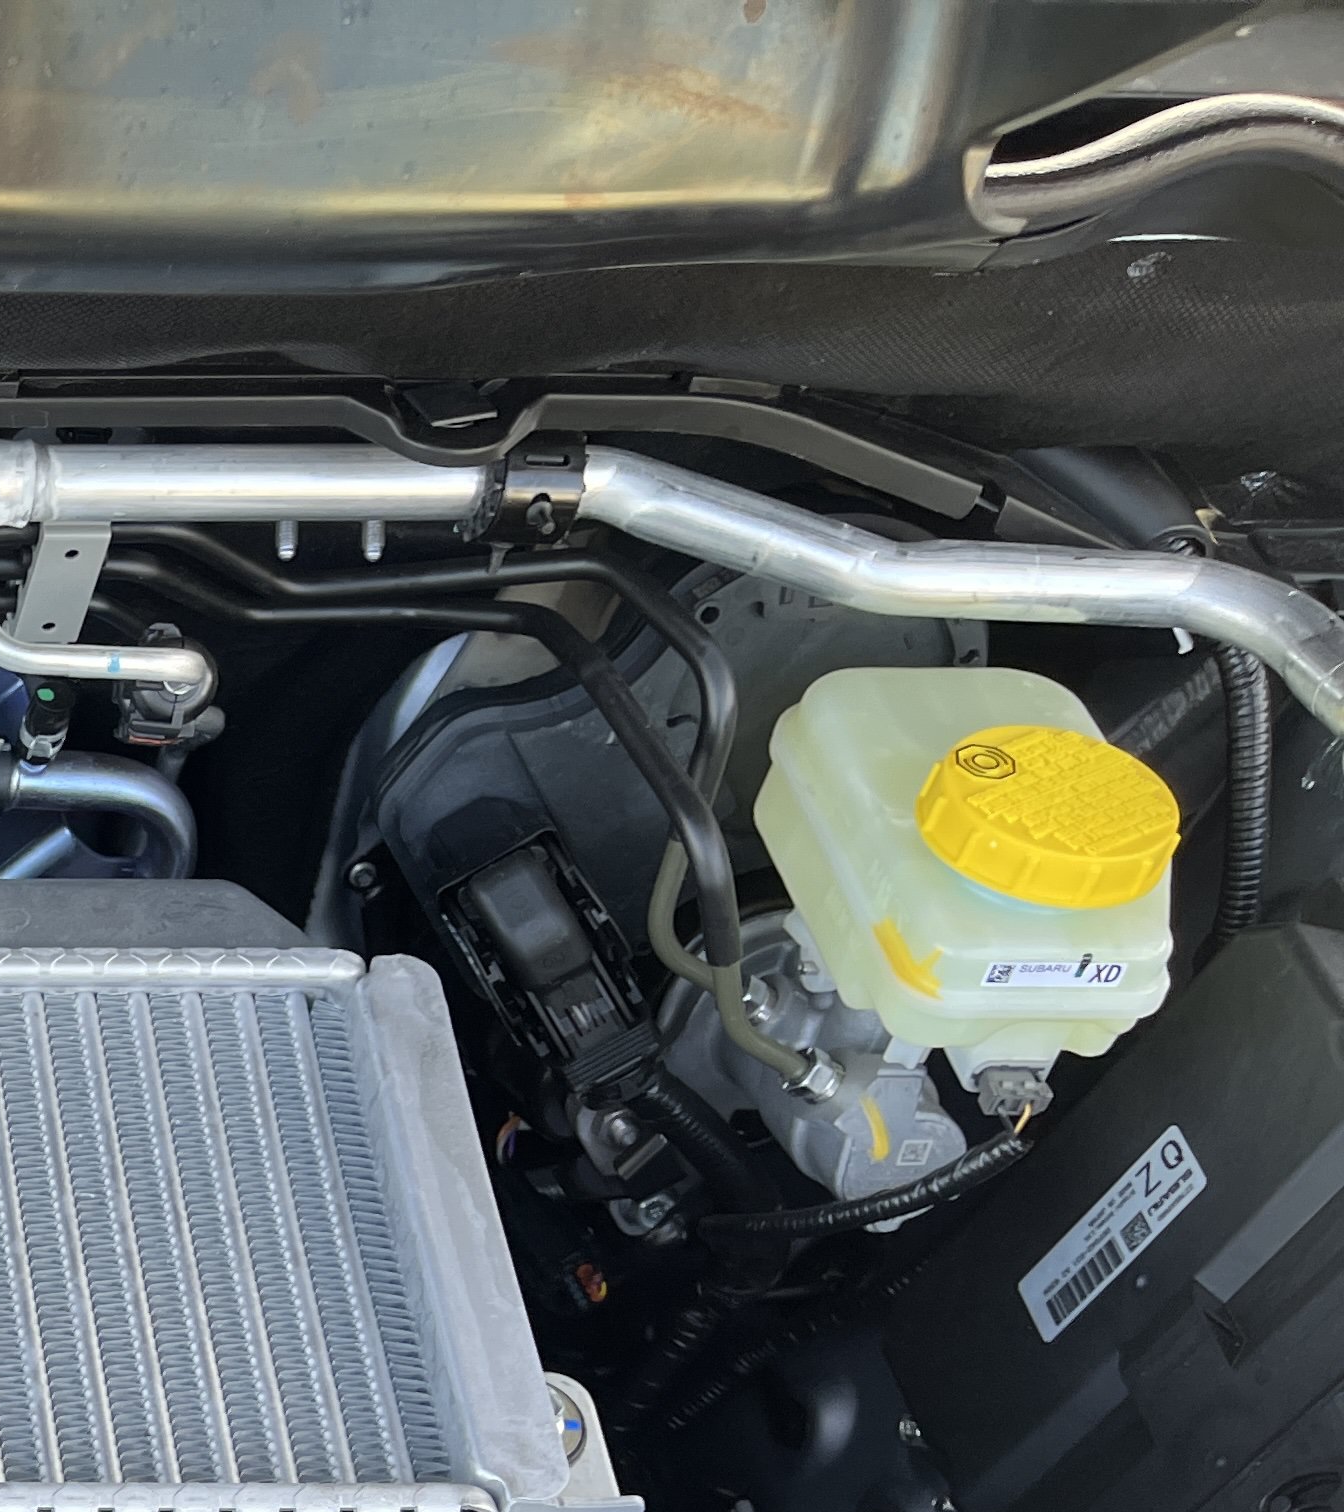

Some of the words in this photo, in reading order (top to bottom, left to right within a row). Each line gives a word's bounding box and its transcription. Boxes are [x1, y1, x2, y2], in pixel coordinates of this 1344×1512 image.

[1019, 964, 1072, 973] SUBARU
[1088, 964, 1123, 983] XD
[1148, 1168, 1193, 1216] SUBARU
